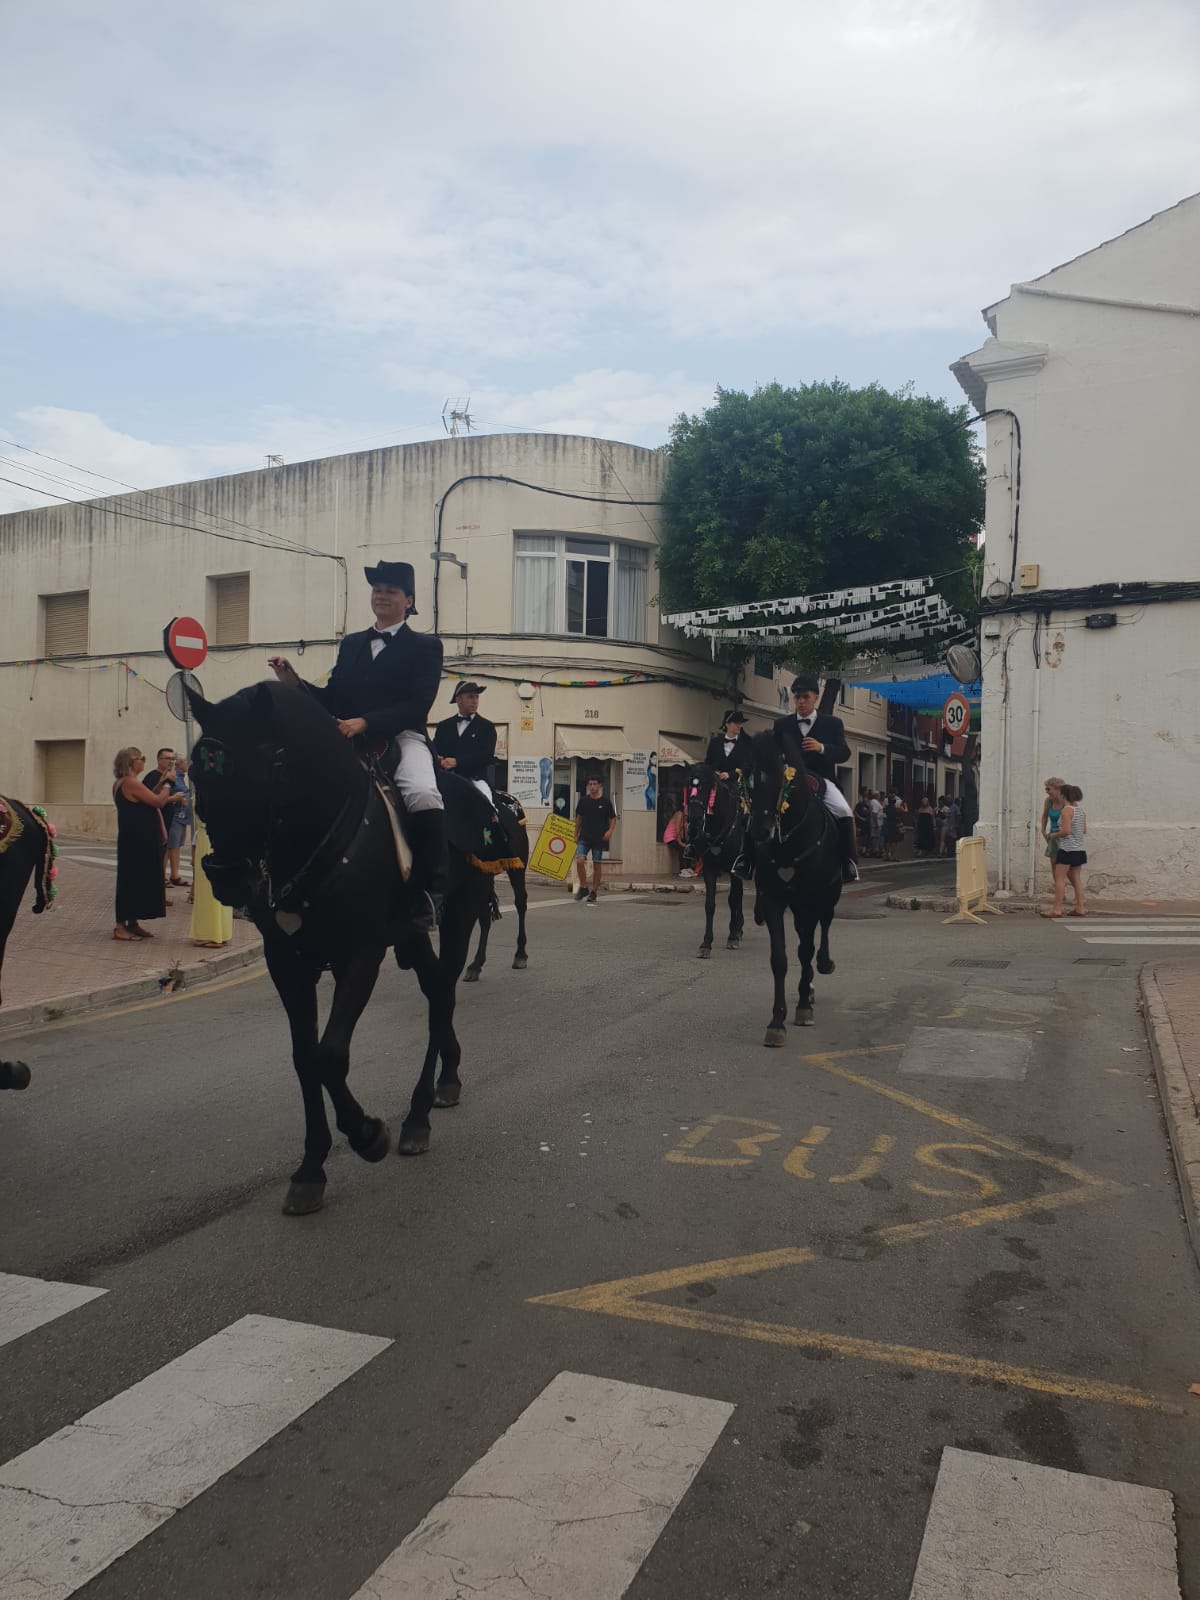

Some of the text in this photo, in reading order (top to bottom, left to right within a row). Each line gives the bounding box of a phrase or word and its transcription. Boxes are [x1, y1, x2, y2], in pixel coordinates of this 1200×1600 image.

[584, 709, 599, 719] 218
[948, 705, 963, 724] 30
[664, 1114, 1002, 1200] BUS
